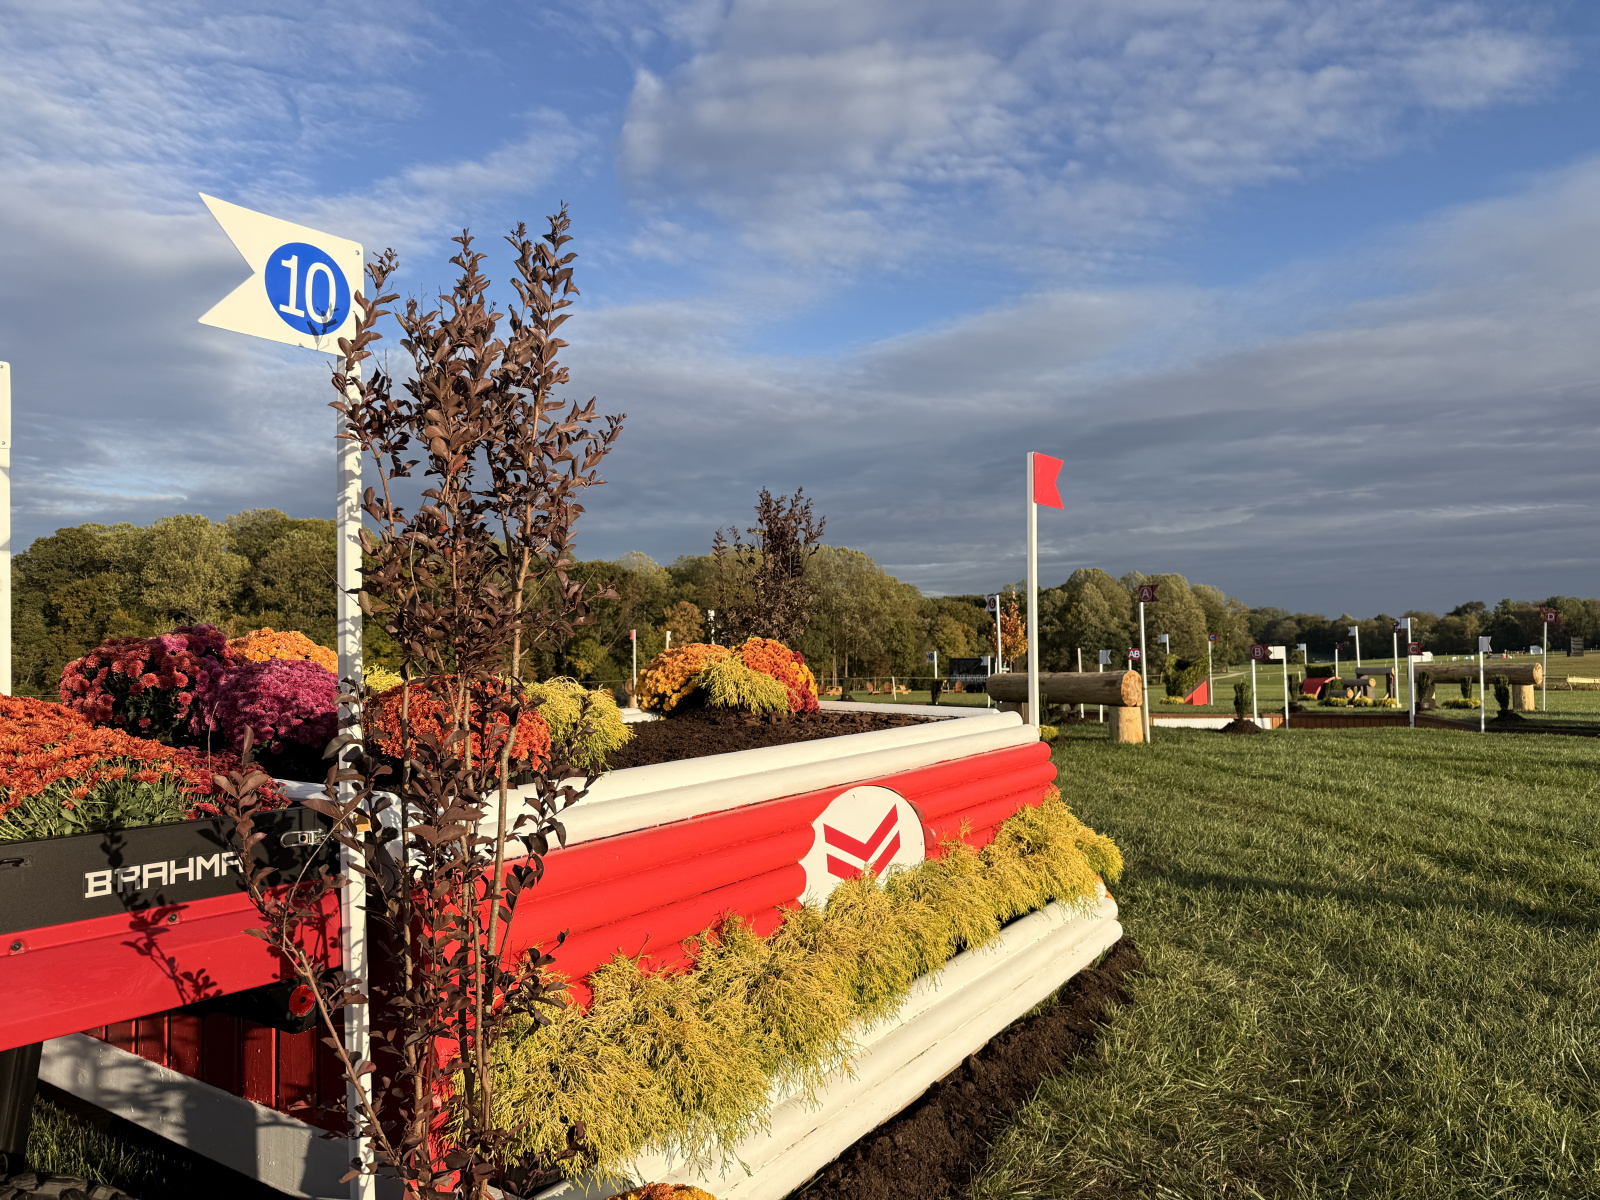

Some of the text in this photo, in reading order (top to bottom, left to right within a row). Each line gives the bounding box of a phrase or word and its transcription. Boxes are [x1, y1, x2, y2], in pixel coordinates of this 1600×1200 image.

[279, 254, 336, 323] 10
[1142, 588, 1150, 599] A
[1129, 650, 1140, 658] AB
[1254, 647, 1261, 657] B
[1409, 645, 1417, 654] C
[85, 851, 244, 898] BRAHMA
